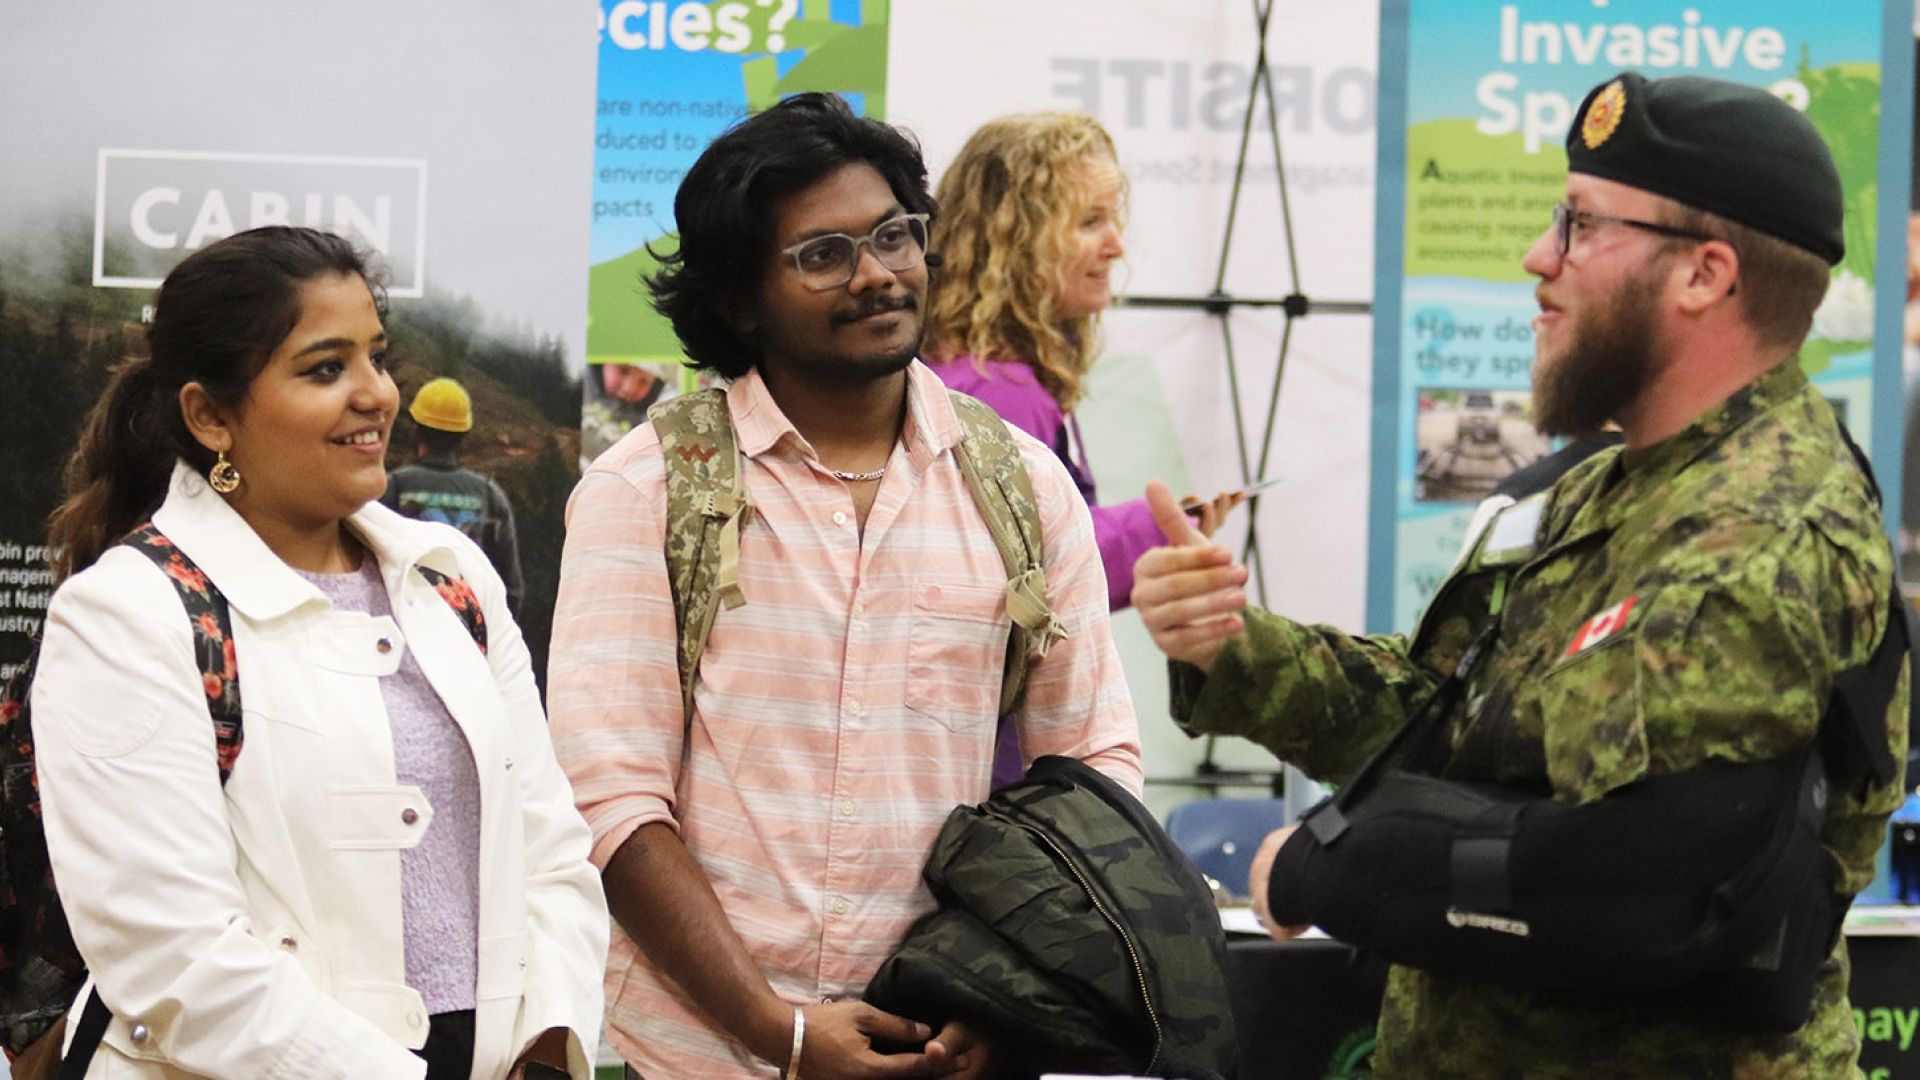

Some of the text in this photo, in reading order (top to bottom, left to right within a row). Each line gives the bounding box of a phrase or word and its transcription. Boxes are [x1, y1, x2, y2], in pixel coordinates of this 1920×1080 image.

[1501, 6, 1787, 70] Invasive
[597, 100, 631, 117] are
[597, 128, 667, 149] duced
[674, 131, 697, 150] to
[594, 198, 653, 224] pacts
[1415, 314, 1531, 342] How do
[1416, 349, 1481, 379] they
[0, 615, 40, 637] ustry
